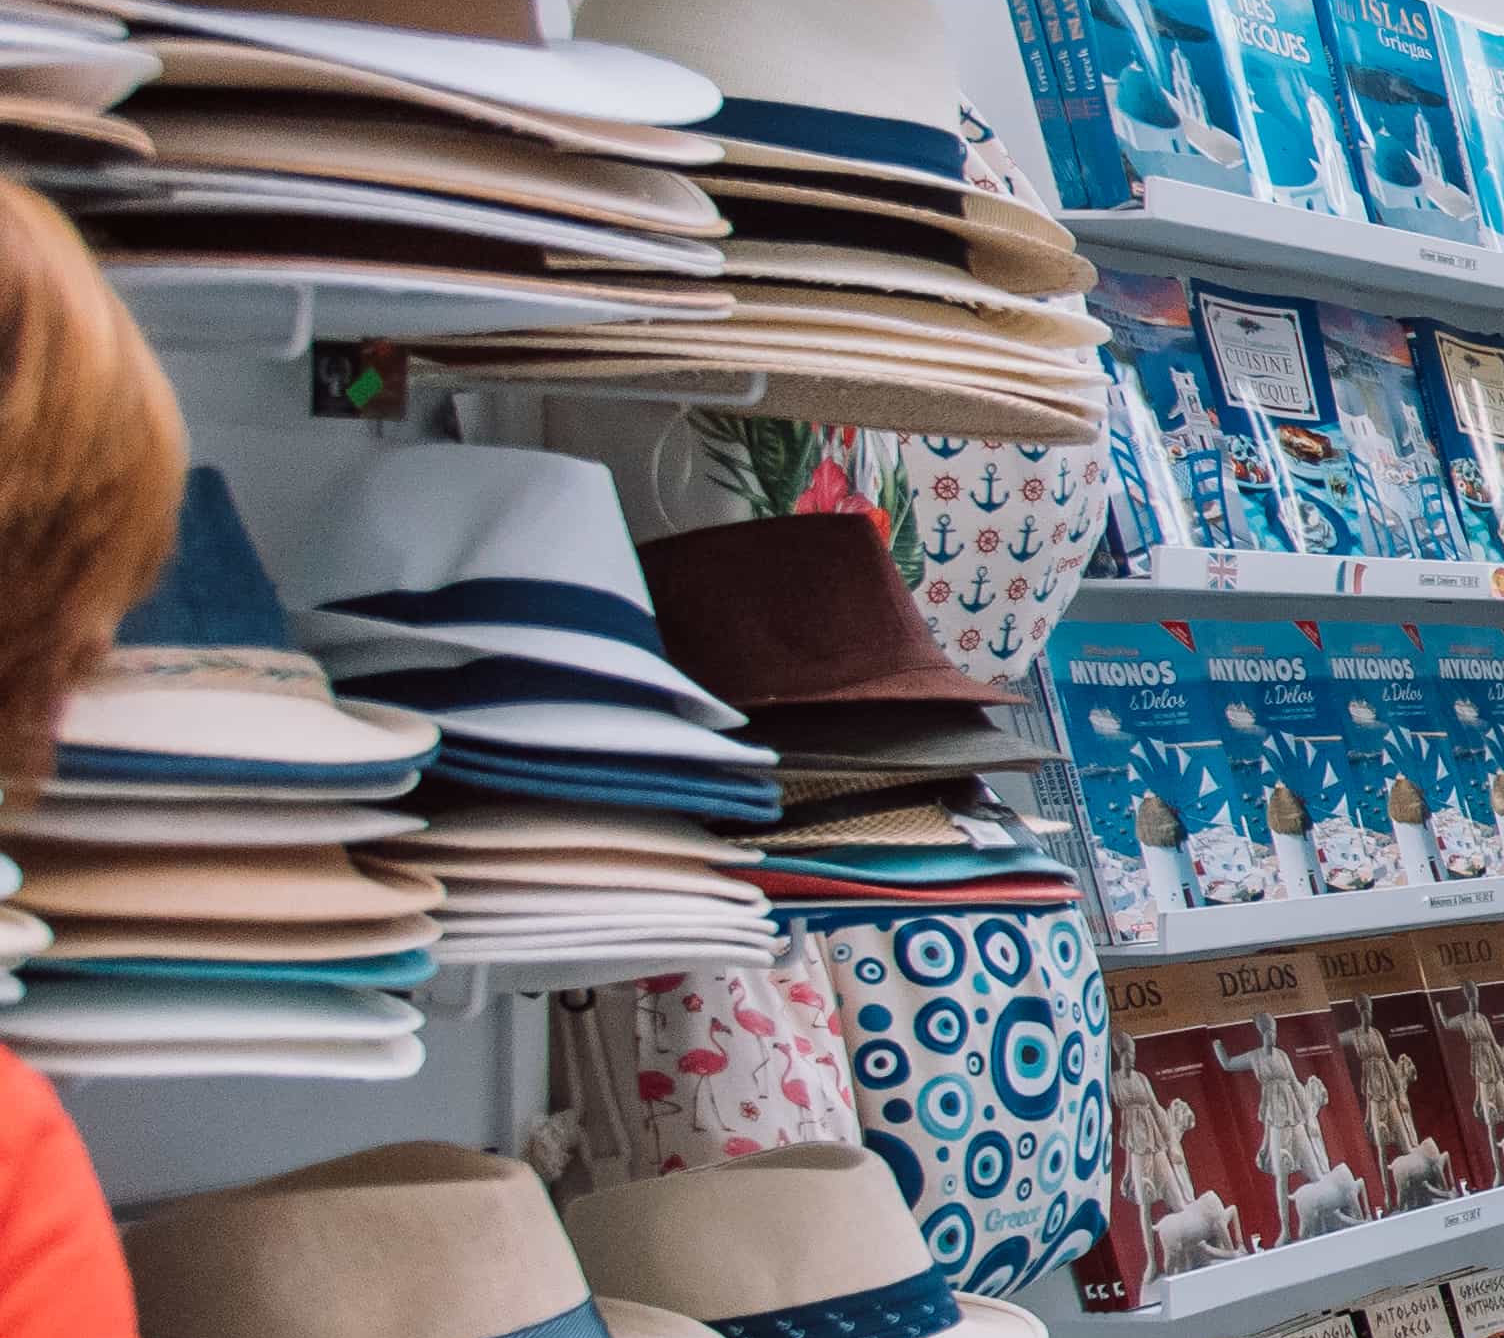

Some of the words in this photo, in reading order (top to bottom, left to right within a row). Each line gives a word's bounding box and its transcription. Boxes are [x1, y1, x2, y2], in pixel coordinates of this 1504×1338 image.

[1230, 11, 1310, 64] RECQUES
[1377, 28, 1433, 61] Griegas
[1224, 346, 1295, 376] CUISINE
[1069, 660, 1177, 686] MYKONOS
[1208, 658, 1307, 682] MYKONOS
[1332, 658, 1415, 680] MYKONOS
[1141, 688, 1188, 710] Delos
[1274, 684, 1316, 705] Delos
[1391, 682, 1424, 701] Delos
[1322, 946, 1395, 979] DELOS
[1108, 980, 1163, 1012] LOS
[1217, 963, 1298, 999] DÉLOS
[1375, 1296, 1440, 1327] MITOLOGIA
